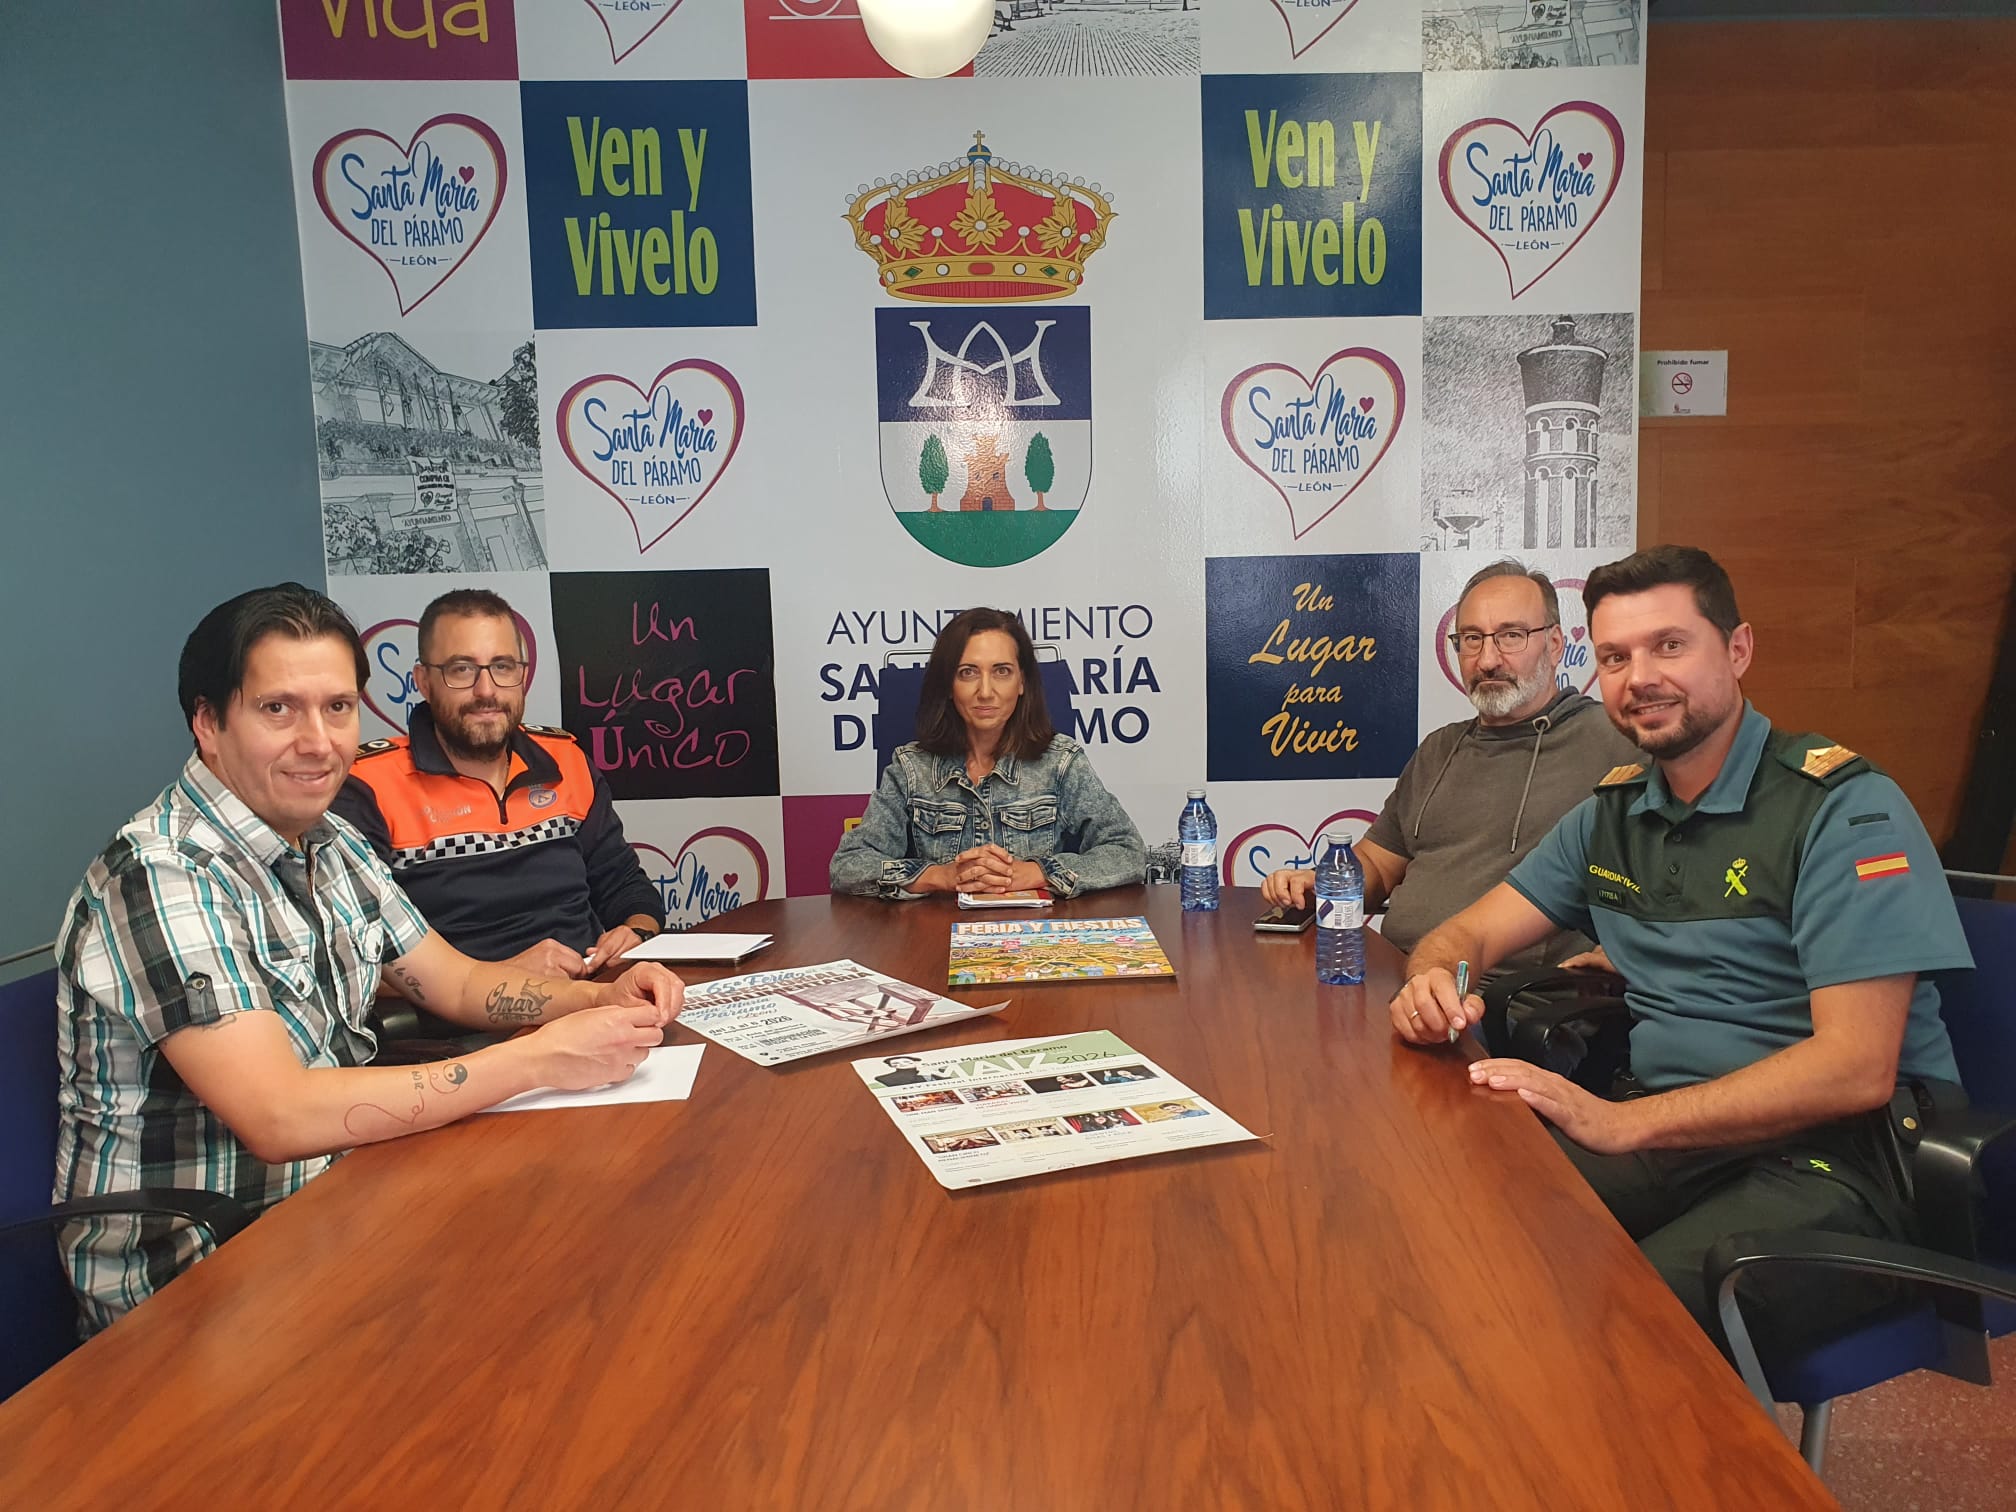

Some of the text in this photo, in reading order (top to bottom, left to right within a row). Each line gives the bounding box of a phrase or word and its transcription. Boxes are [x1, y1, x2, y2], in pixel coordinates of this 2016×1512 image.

[567, 116, 707, 212] Ven y
[1244, 109, 1381, 203] Ven y
[1465, 141, 1534, 207] Santa
[341, 153, 415, 221] Santa
[371, 214, 464, 248] DEL PÁRAMO
[1489, 200, 1578, 232] DEL PÁRAMO
[401, 254, 437, 266] LEÓN
[564, 210, 719, 297] Vivelo
[1238, 202, 1387, 287] Vivelo
[1516, 239, 1550, 250] LEÓN
[583, 397, 655, 462] Santa
[1248, 386, 1317, 450] Santa
[611, 455, 701, 487] DEL PÁRAMO
[1271, 442, 1360, 474] DEL PÁRAMO
[641, 494, 676, 505] LEÓN
[1298, 481, 1333, 493] LEÓN
[1292, 583, 1335, 612] Un
[633, 601, 700, 646] Un
[827, 605, 1152, 645] AYUNIENTO
[1248, 619, 1377, 678] Lugar
[579, 665, 757, 739] Lugar
[1281, 683, 1343, 711] para
[1261, 711, 1359, 757] Vivir
[1588, 864, 1641, 894] GUARDIA IVIL
[957, 922, 1023, 935] FERIA
[1027, 921, 1045, 933] Y
[1050, 919, 1144, 932] FIESTAS
[1056, 1051, 1118, 1065] 2026
